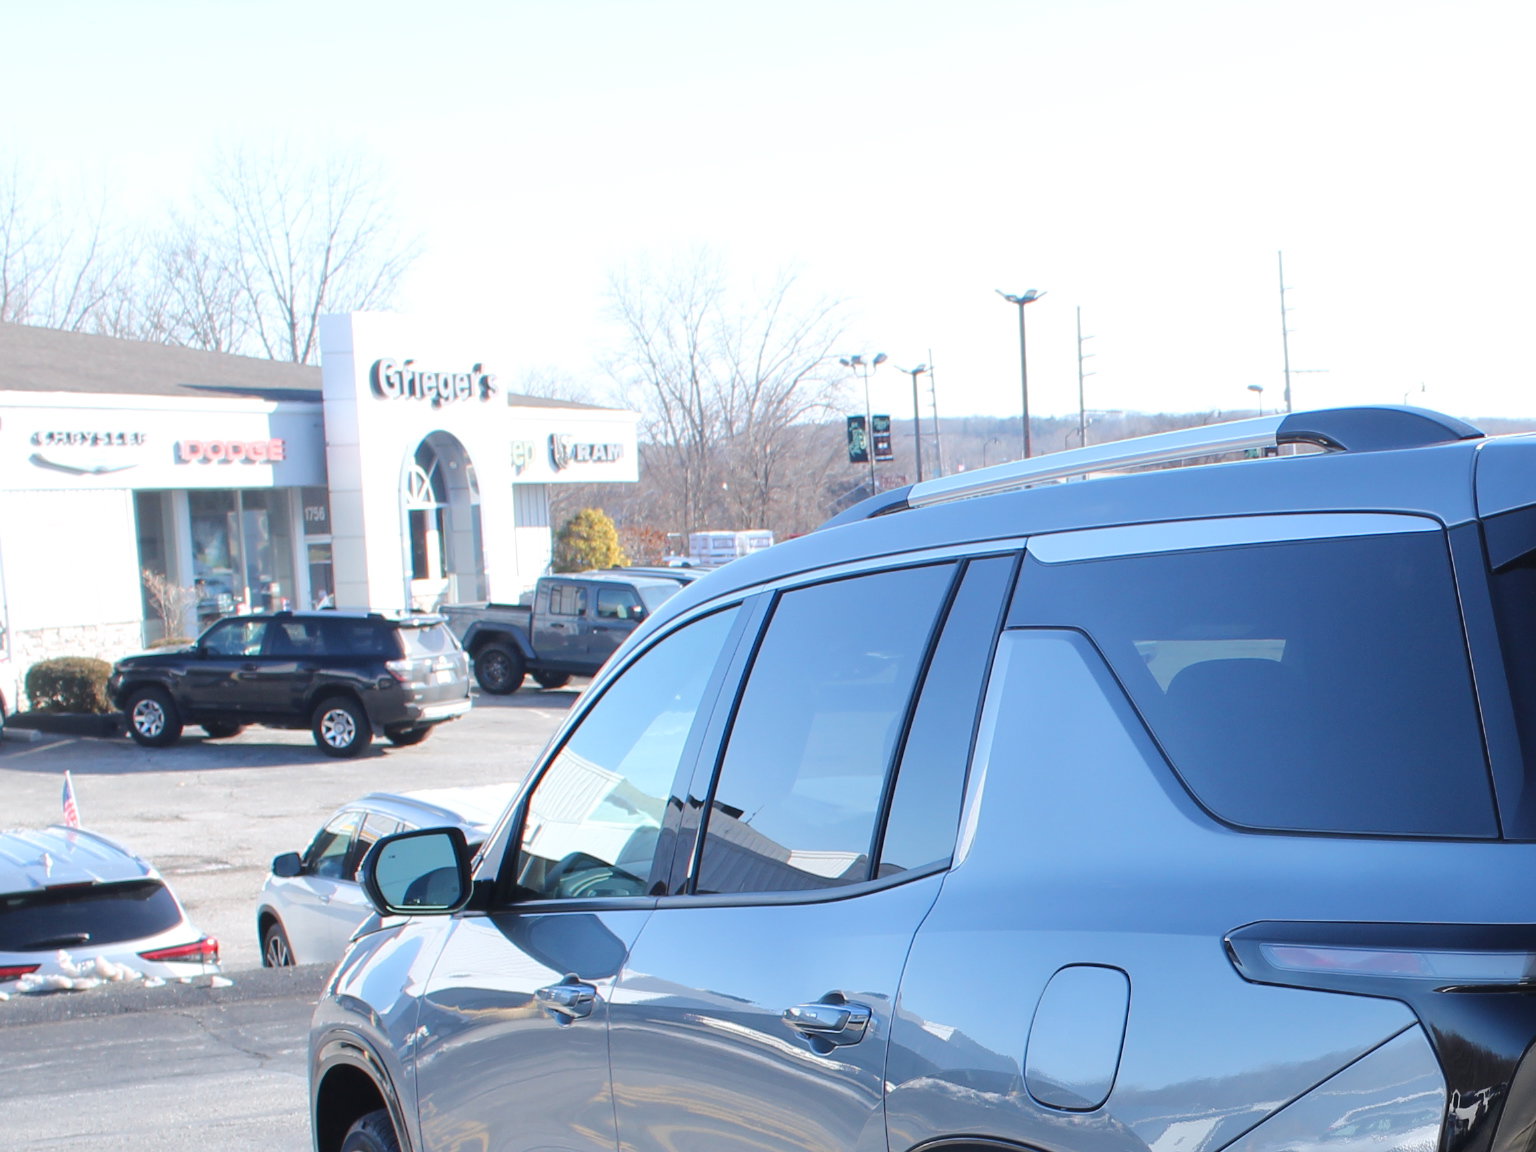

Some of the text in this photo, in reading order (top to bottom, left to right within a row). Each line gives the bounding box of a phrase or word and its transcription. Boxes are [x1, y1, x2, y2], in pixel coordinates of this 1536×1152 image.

[369, 357, 499, 410] Grieger's
[174, 438, 287, 464] DODGE
[572, 443, 624, 463] RAM
[304, 505, 326, 522] 1756
